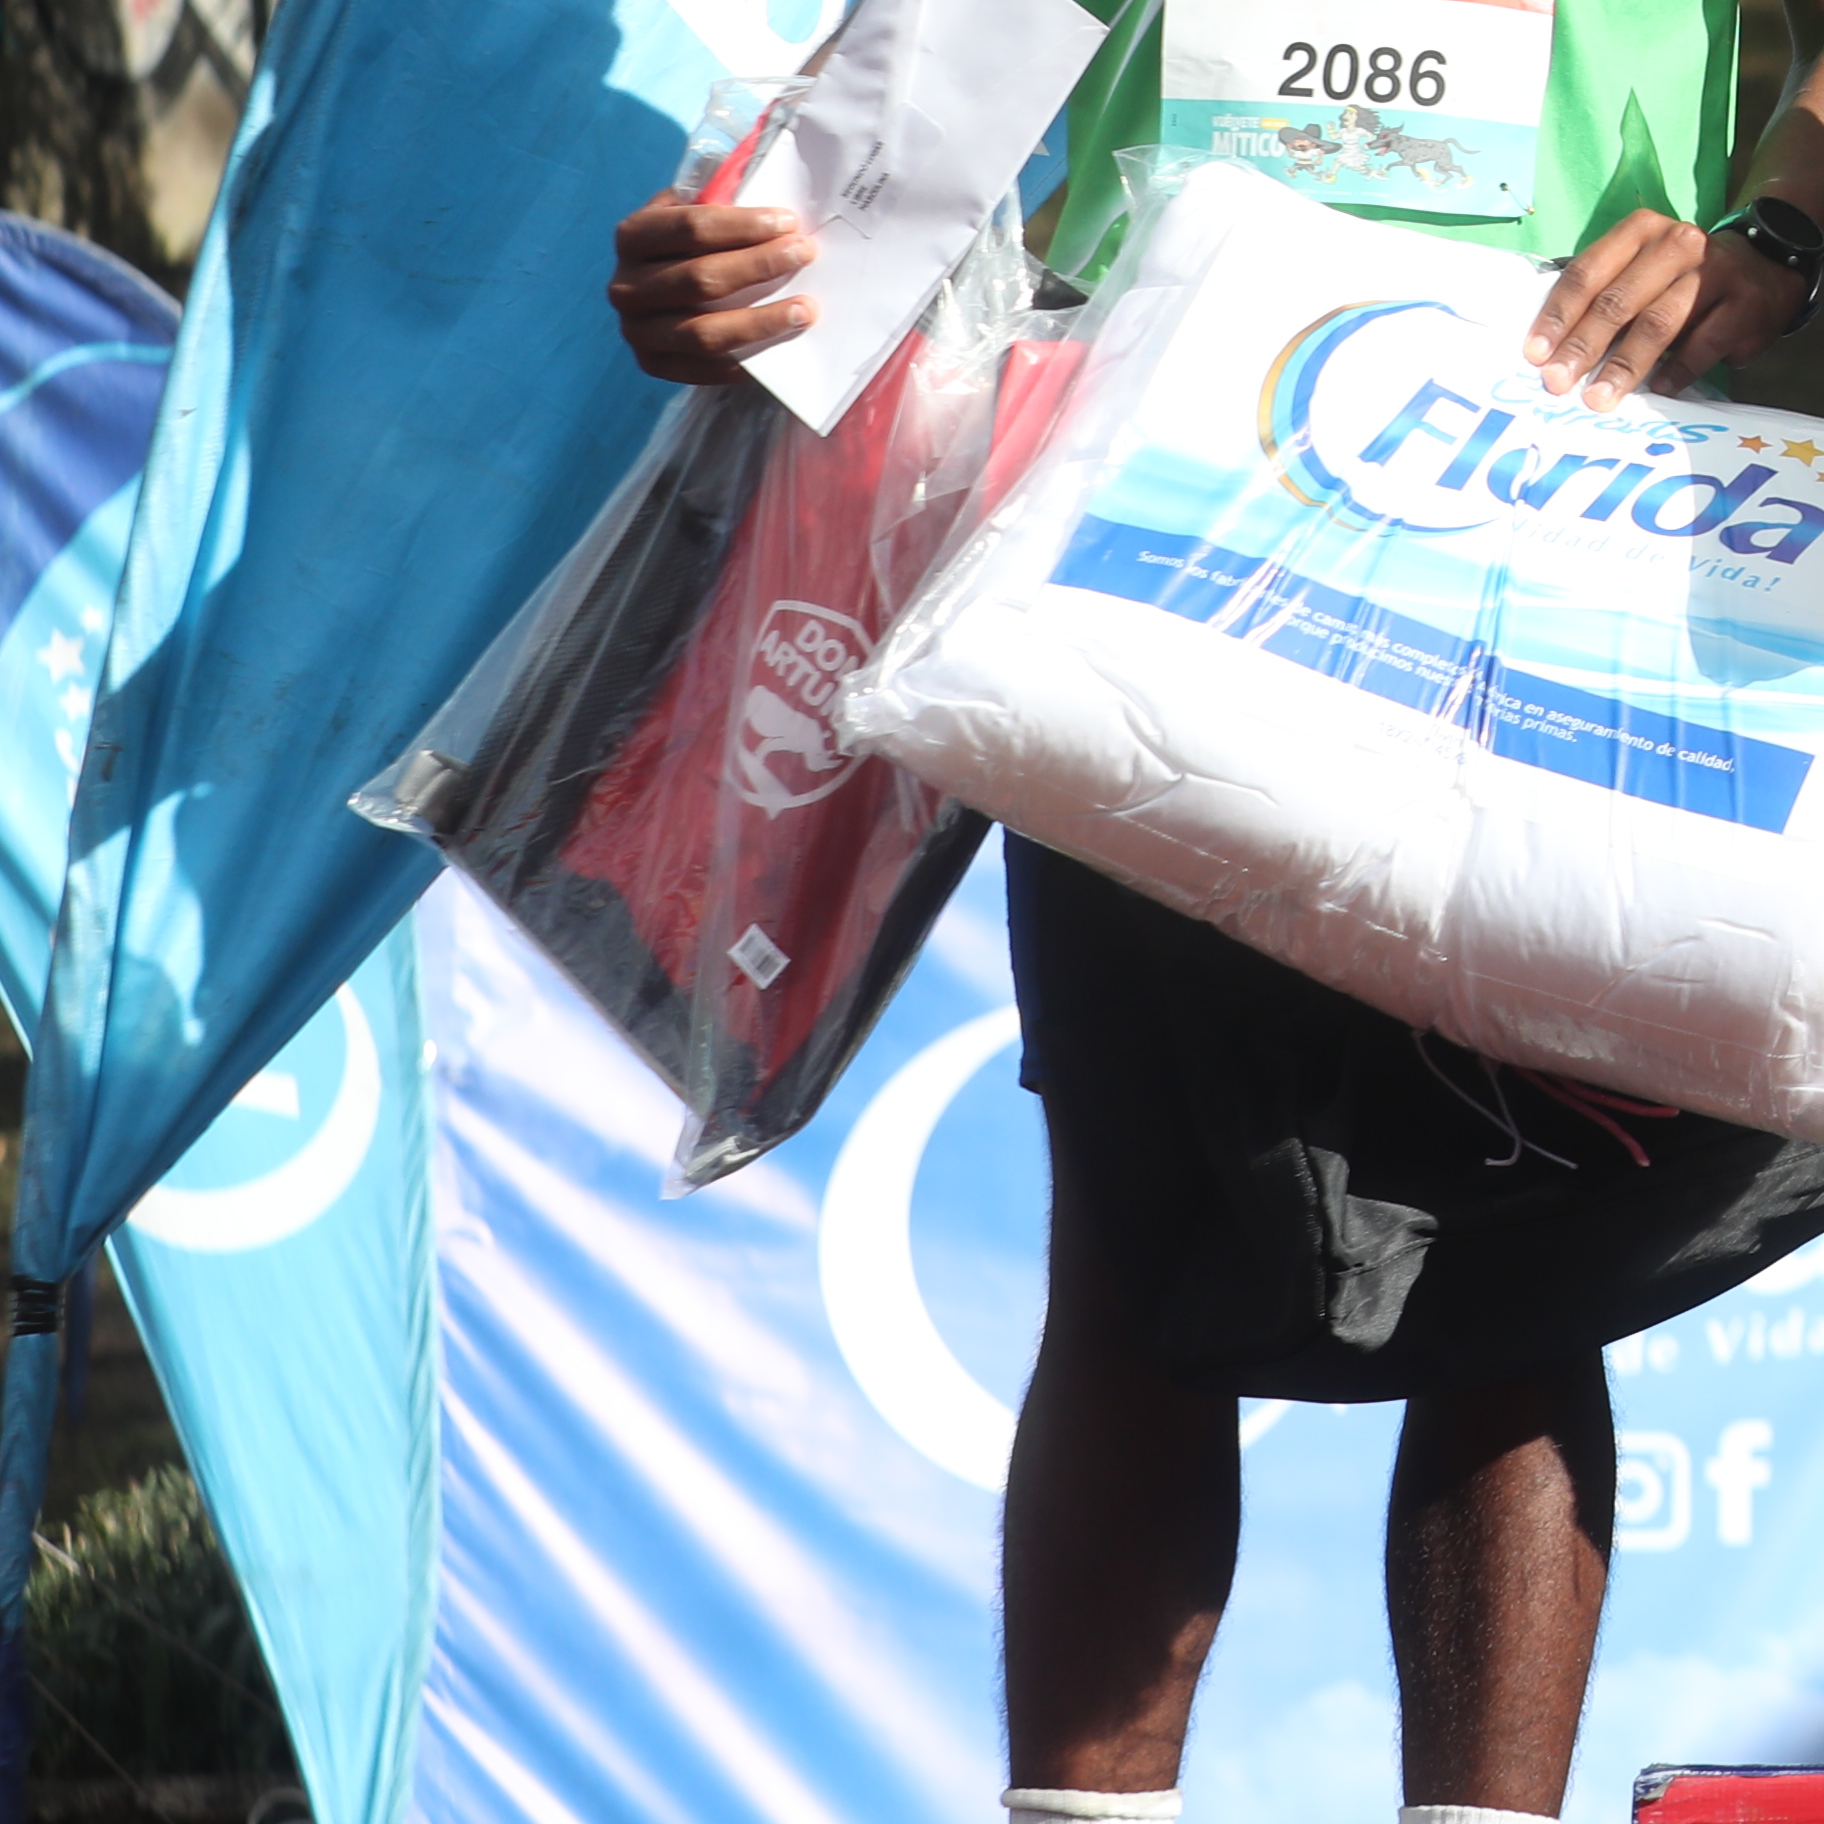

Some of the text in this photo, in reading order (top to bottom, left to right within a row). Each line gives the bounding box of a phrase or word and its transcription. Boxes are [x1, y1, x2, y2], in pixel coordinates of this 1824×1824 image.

[1276, 41, 1449, 108] 2086
[1136, 550, 1184, 568] Somos
[1391, 642, 1466, 676] comples
[1524, 702, 1543, 718] en
[1548, 708, 1654, 751] aseguramiento
[1655, 741, 1677, 758] de
[1677, 748, 1736, 773] calidad,
[1287, 616, 1330, 638] orque
[1522, 716, 1577, 743] primas.
